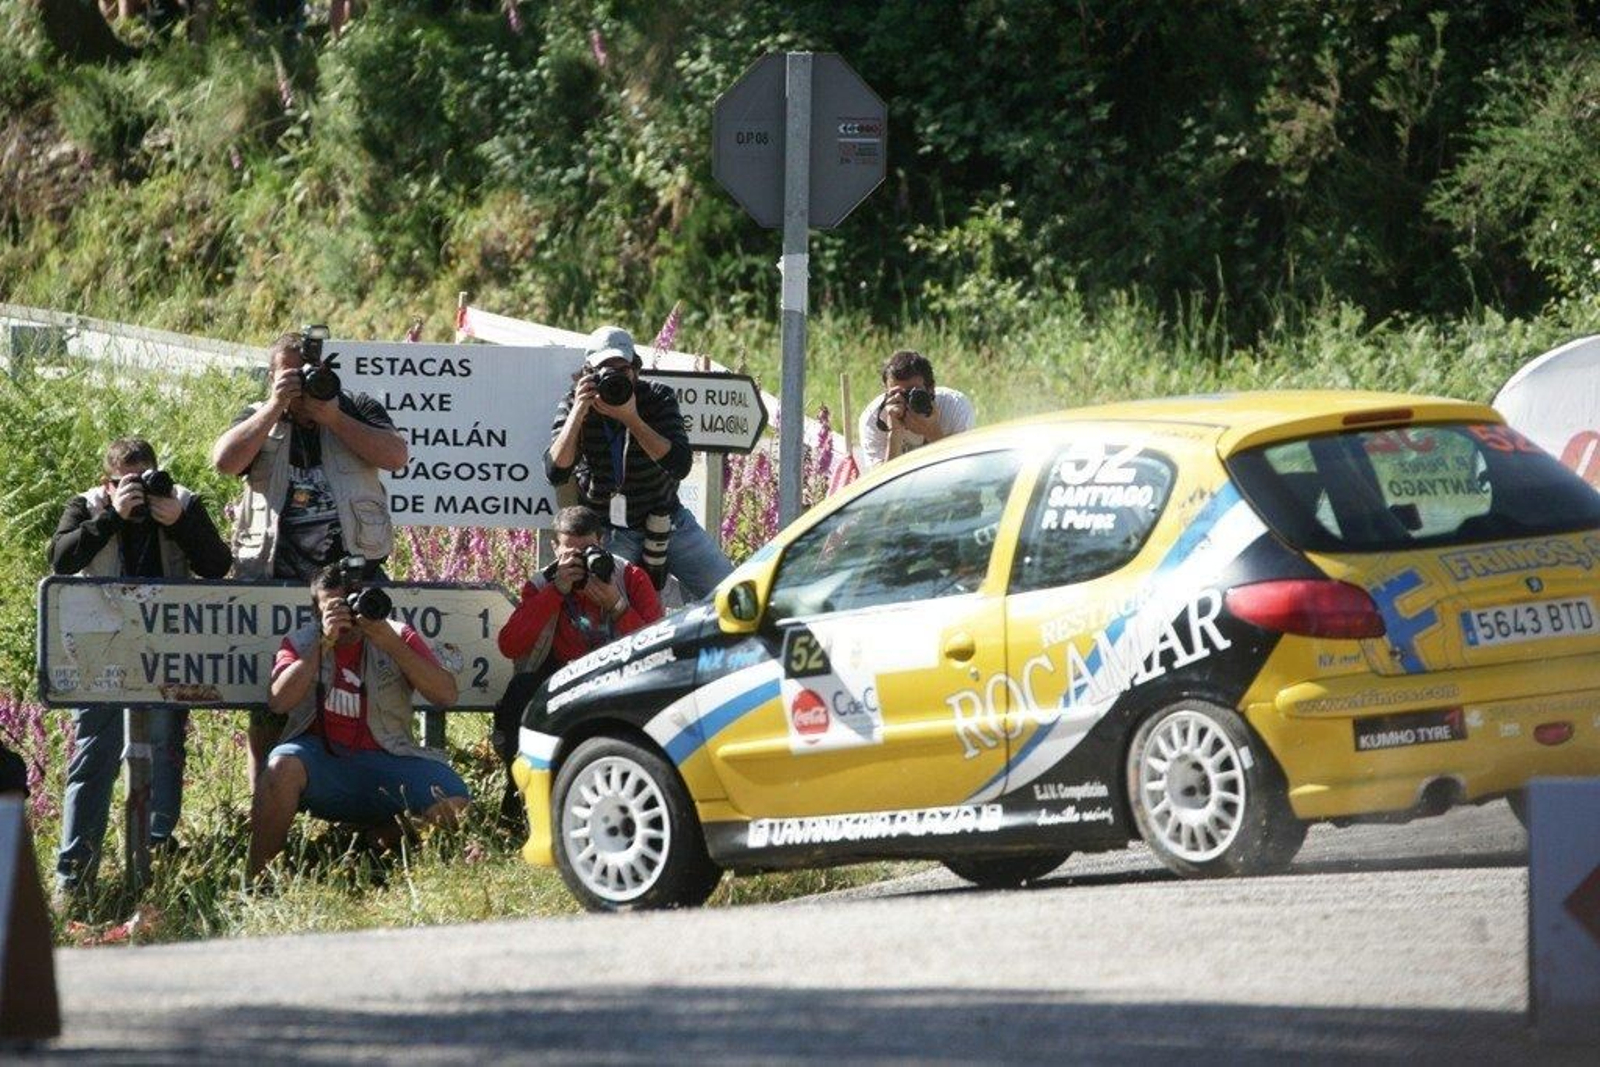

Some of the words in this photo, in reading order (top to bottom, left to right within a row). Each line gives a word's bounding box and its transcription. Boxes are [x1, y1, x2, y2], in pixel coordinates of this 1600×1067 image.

[355, 357, 472, 377] ESTACAS
[385, 393, 452, 412] LAXE
[705, 389, 749, 408] RURAL
[391, 495, 424, 513] DE
[434, 496, 554, 515] MAGINA
[139, 596, 257, 635] VENTÍN
[478, 608, 489, 639] 1
[1477, 607, 1542, 640] 5643
[1546, 601, 1593, 632] BTD
[140, 646, 258, 685] VENTÍN
[471, 657, 490, 688] 2
[791, 635, 824, 672] 52
[946, 588, 1231, 760] ROCAMAR
[1359, 729, 1416, 749] KUMHO
[1418, 725, 1452, 741] TYRE
